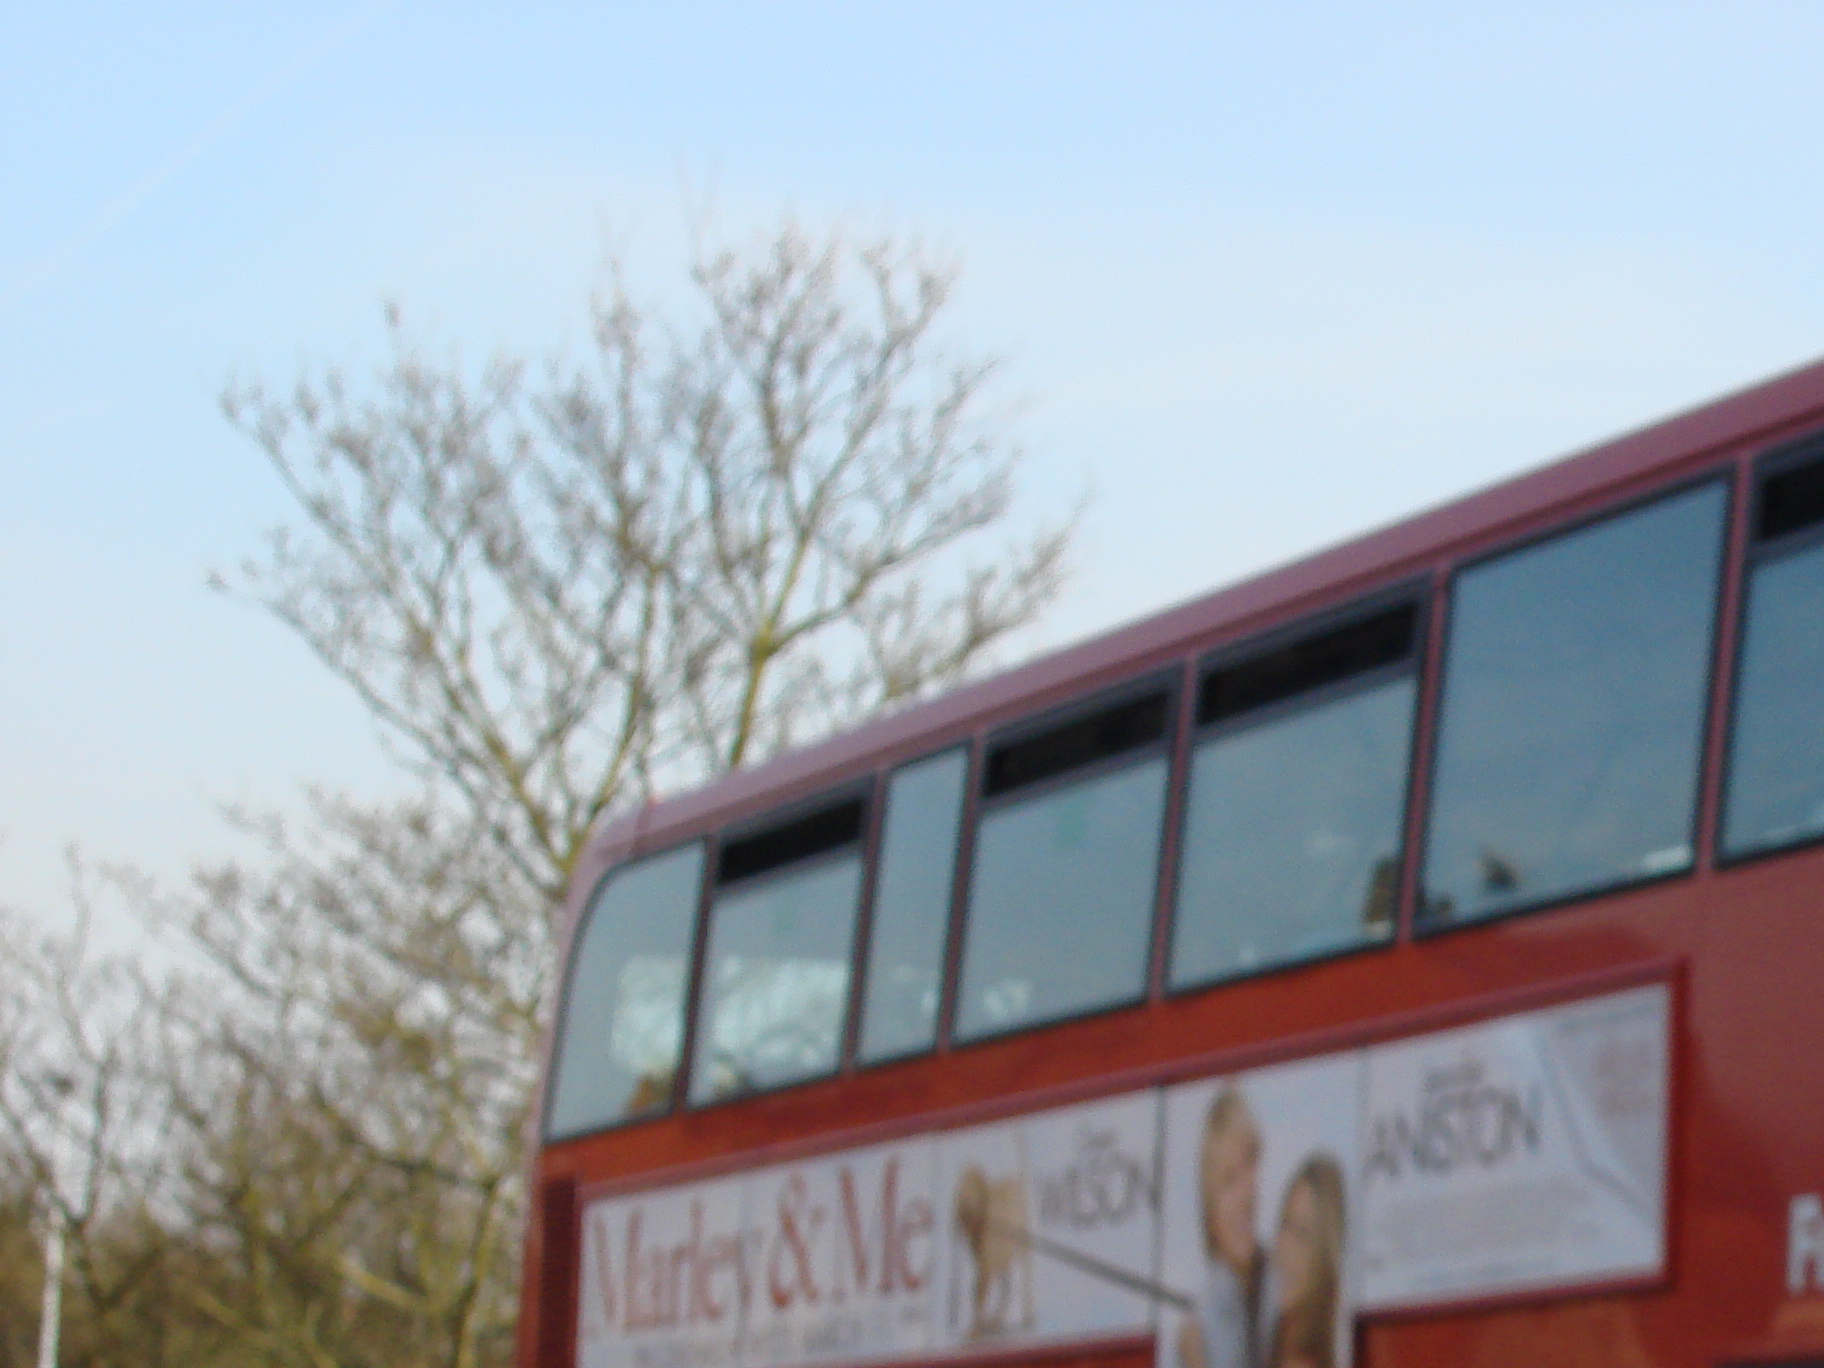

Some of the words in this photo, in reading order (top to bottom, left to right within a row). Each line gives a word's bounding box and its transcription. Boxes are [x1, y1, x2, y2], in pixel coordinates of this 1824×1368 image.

[1359, 1083, 1543, 1181] ANISTON
[1040, 1152, 1165, 1229] WILSON
[588, 1198, 765, 1350] Marley
[766, 1172, 829, 1311] &
[831, 1153, 935, 1303] Me
